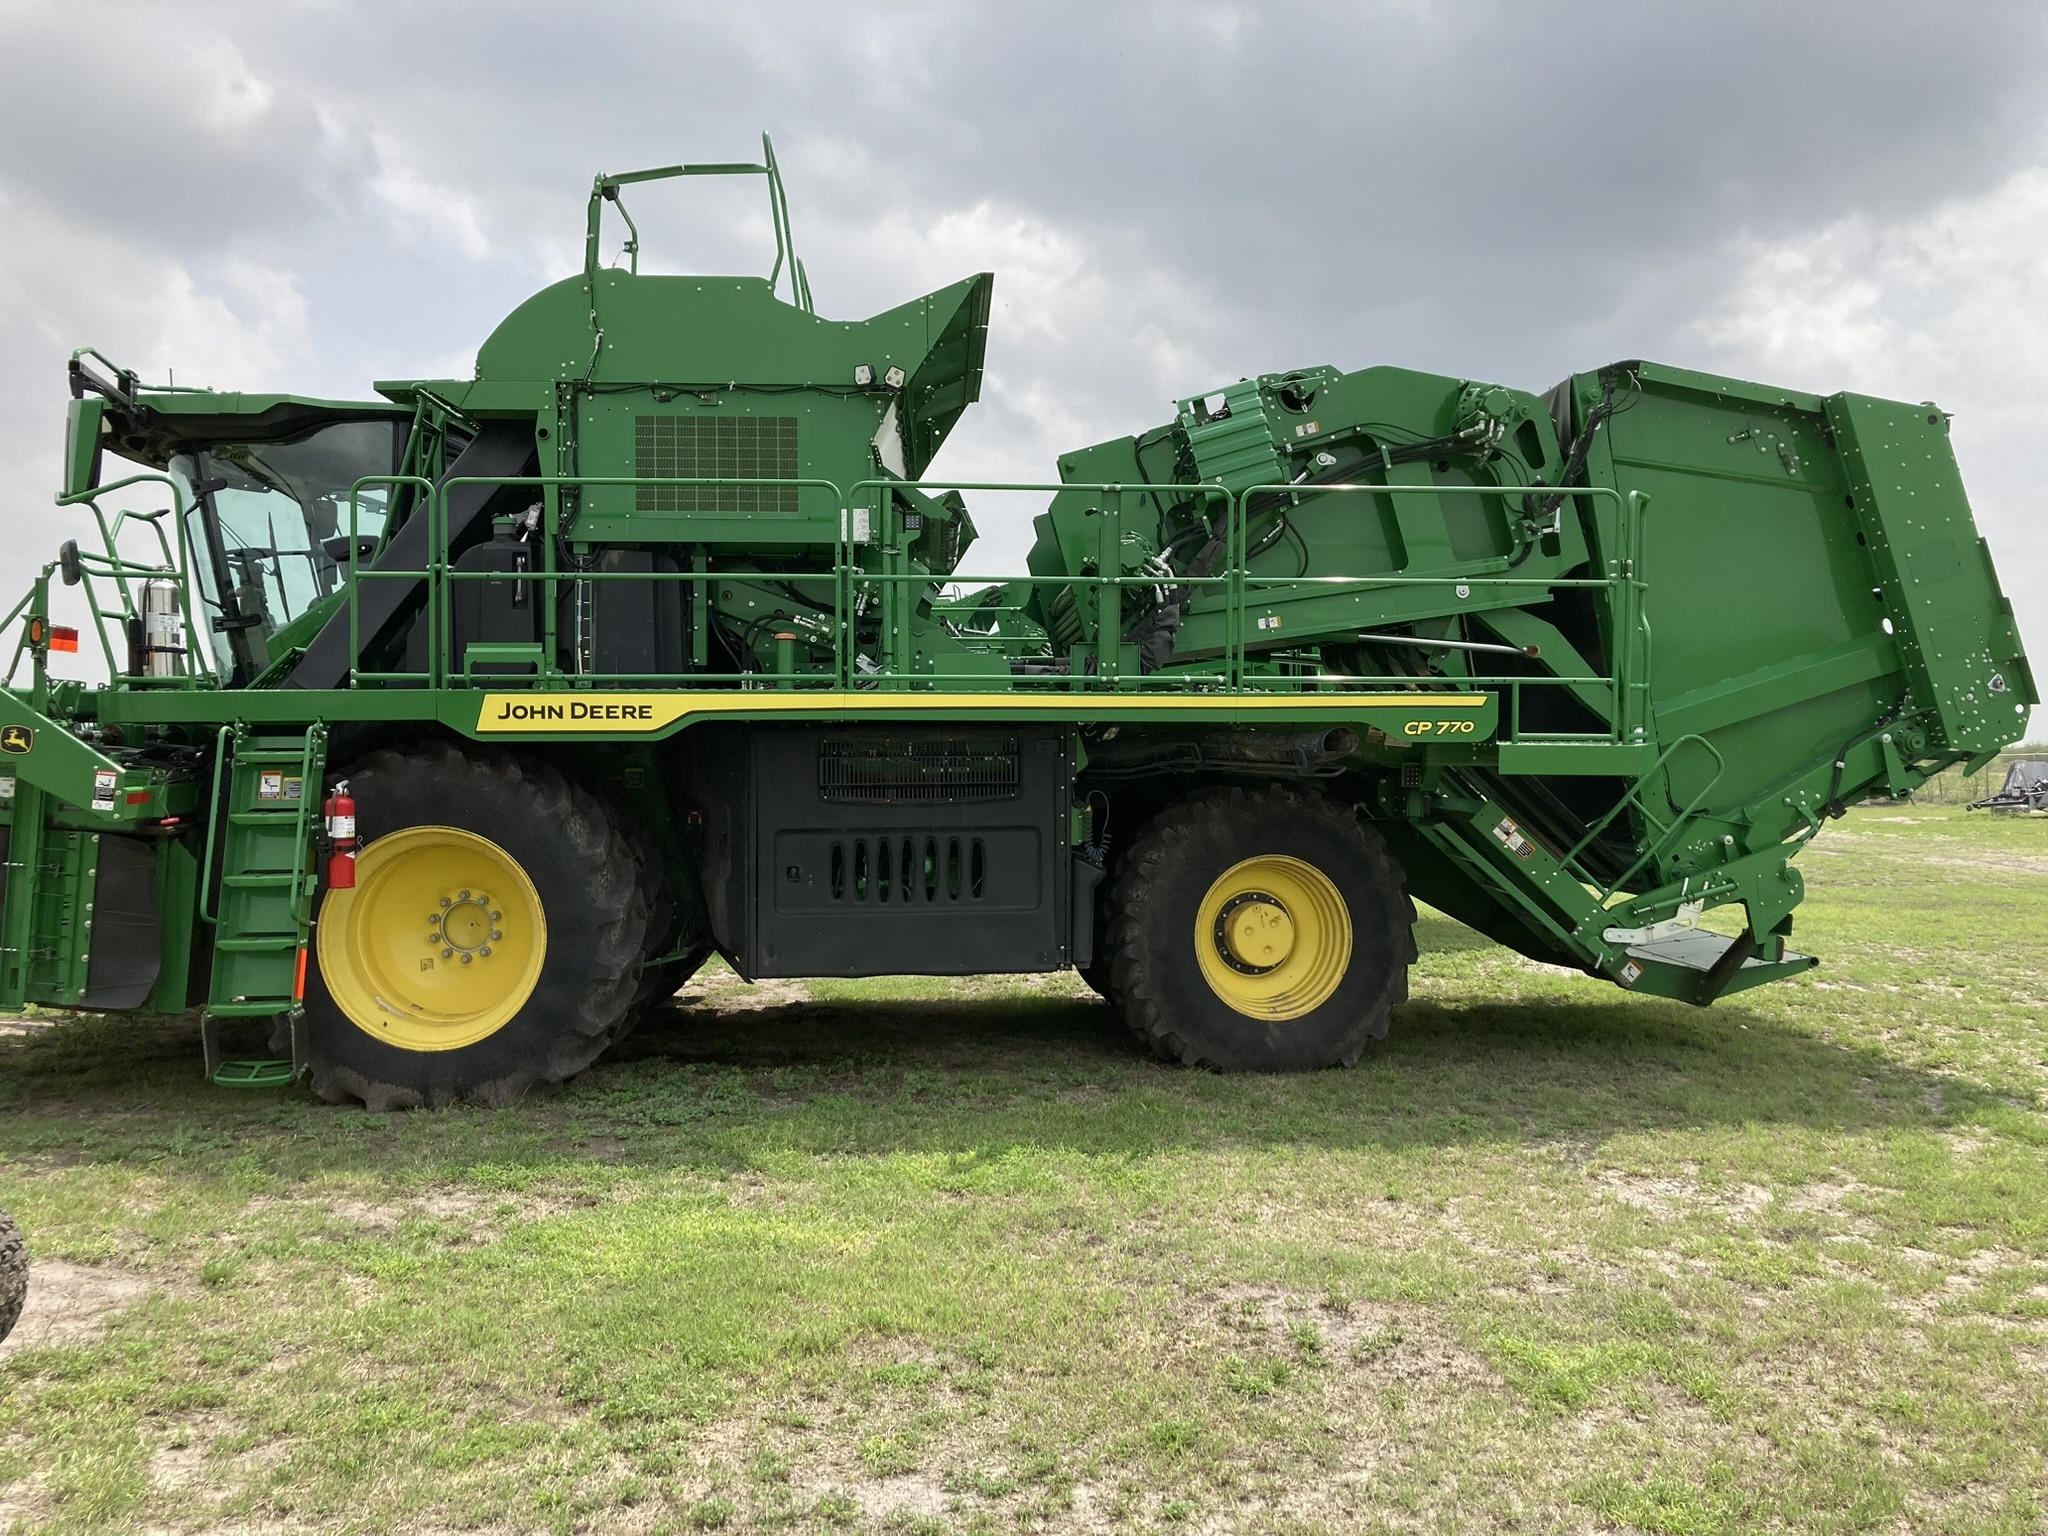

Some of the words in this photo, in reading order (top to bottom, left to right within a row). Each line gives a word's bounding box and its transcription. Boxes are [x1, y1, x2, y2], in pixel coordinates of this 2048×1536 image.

[497, 702, 564, 720] JOHN
[570, 702, 653, 719] DEERE
[1403, 720, 1433, 735] CP
[1435, 720, 1475, 735] 770
